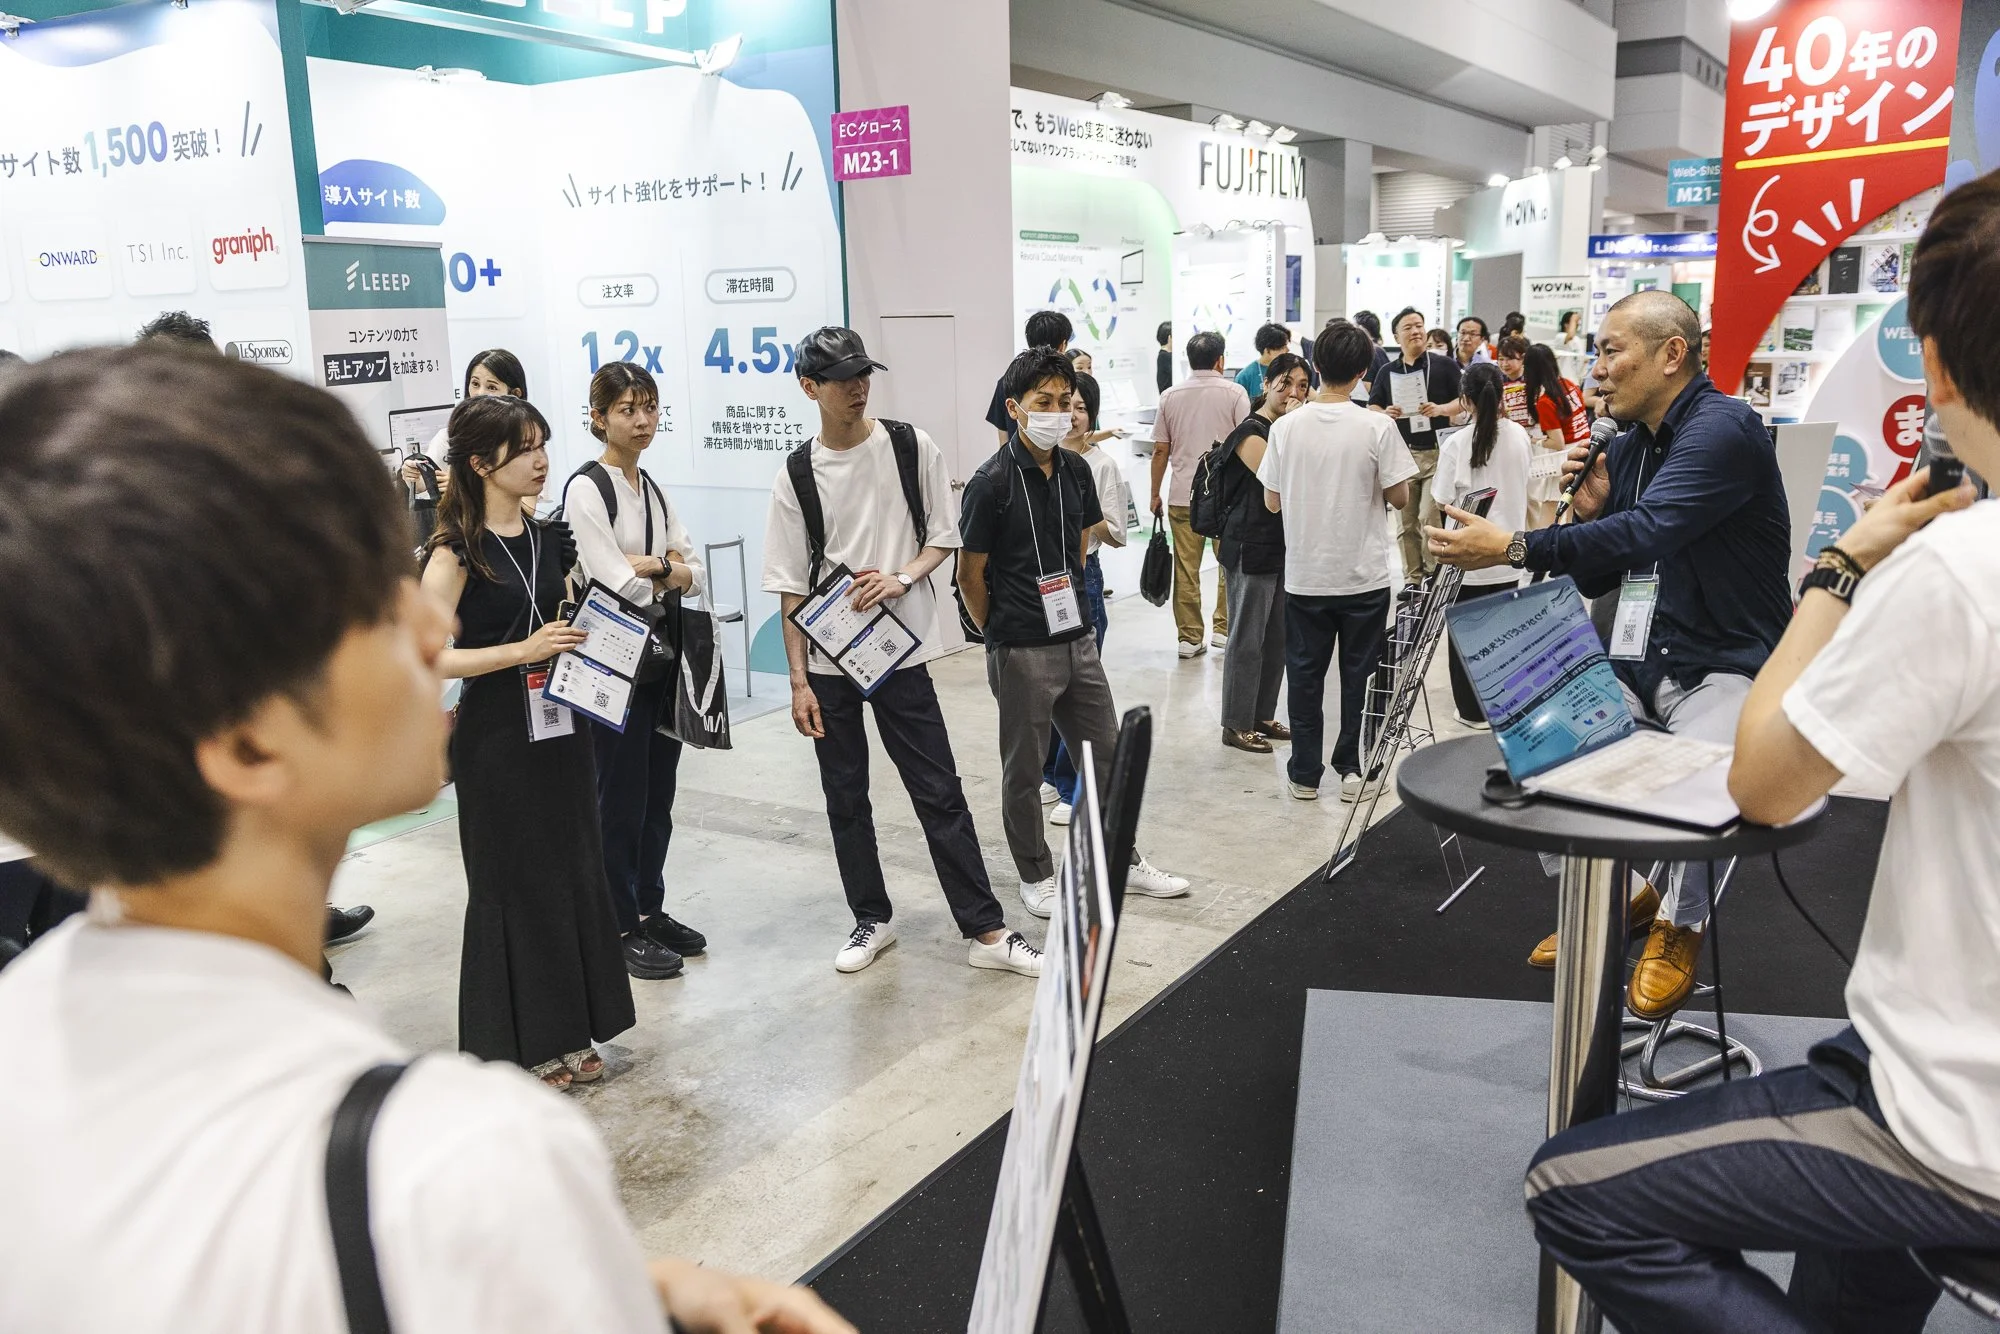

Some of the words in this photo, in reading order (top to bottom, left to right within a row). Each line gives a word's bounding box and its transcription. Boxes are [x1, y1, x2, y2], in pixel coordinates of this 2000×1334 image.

[1743, 16, 1938, 92] 40年の
[838, 117, 902, 139] ECグロース
[1741, 81, 1954, 156] デザイン
[843, 148, 900, 174] M23-1
[1200, 141, 1306, 199] FUJIFILM
[324, 185, 421, 209] 導入サイト数
[39, 249, 98, 267] ONWARD
[126, 244, 153, 263] TSI
[162, 242, 189, 261] Inc.
[361, 272, 411, 291] LEEEP
[441, 252, 501, 292] 0+
[602, 284, 634, 299] 注文率
[726, 278, 774, 294] 滞在時間
[349, 328, 418, 344] コンテンツの力で
[581, 330, 664, 374] 12x
[704, 327, 797, 374] 4.5x
[726, 405, 786, 418] 商品に関する
[712, 421, 802, 435] 情報を増やすことで
